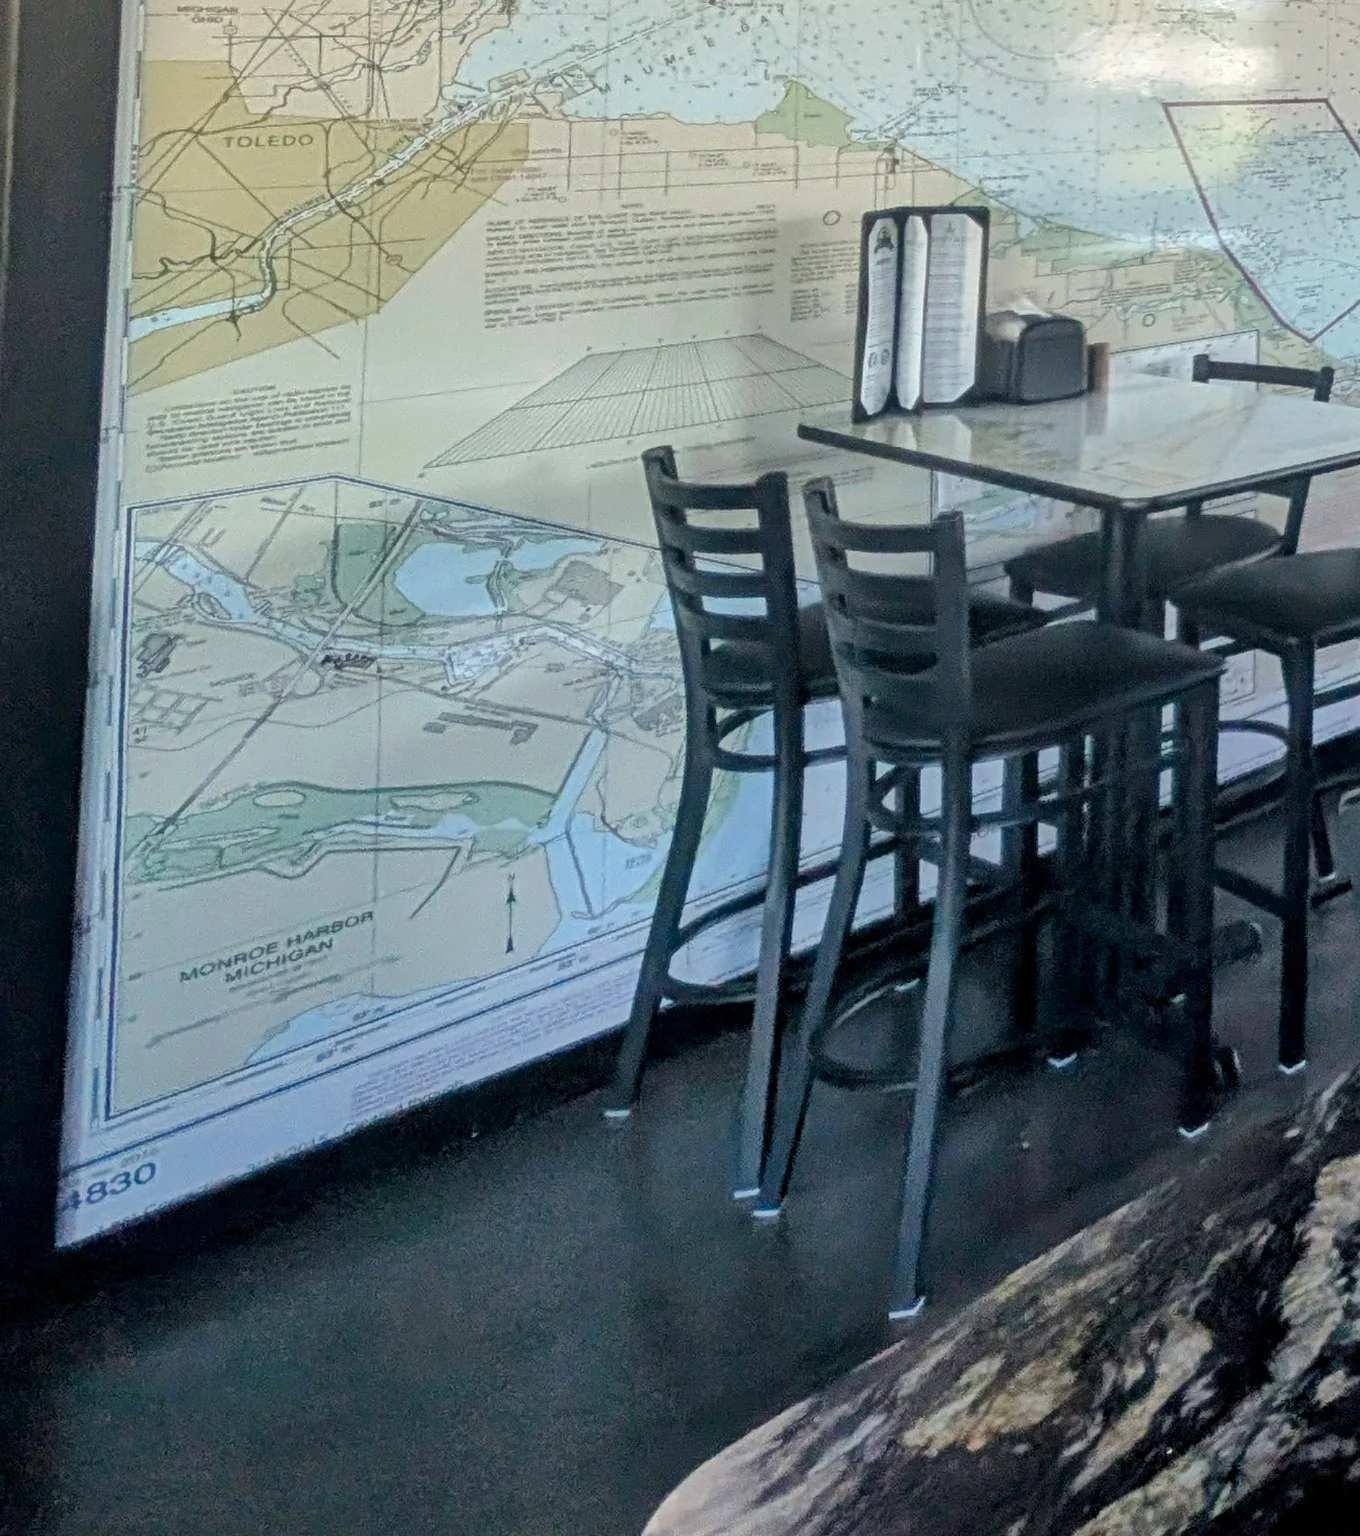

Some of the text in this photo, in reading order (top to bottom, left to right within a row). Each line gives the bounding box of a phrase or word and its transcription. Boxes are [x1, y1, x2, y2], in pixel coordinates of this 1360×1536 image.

[223, 134, 314, 149] TOLEDO
[179, 941, 279, 983] MONROE
[286, 910, 375, 948] HARBOR
[225, 937, 333, 983] MICHIGAN
